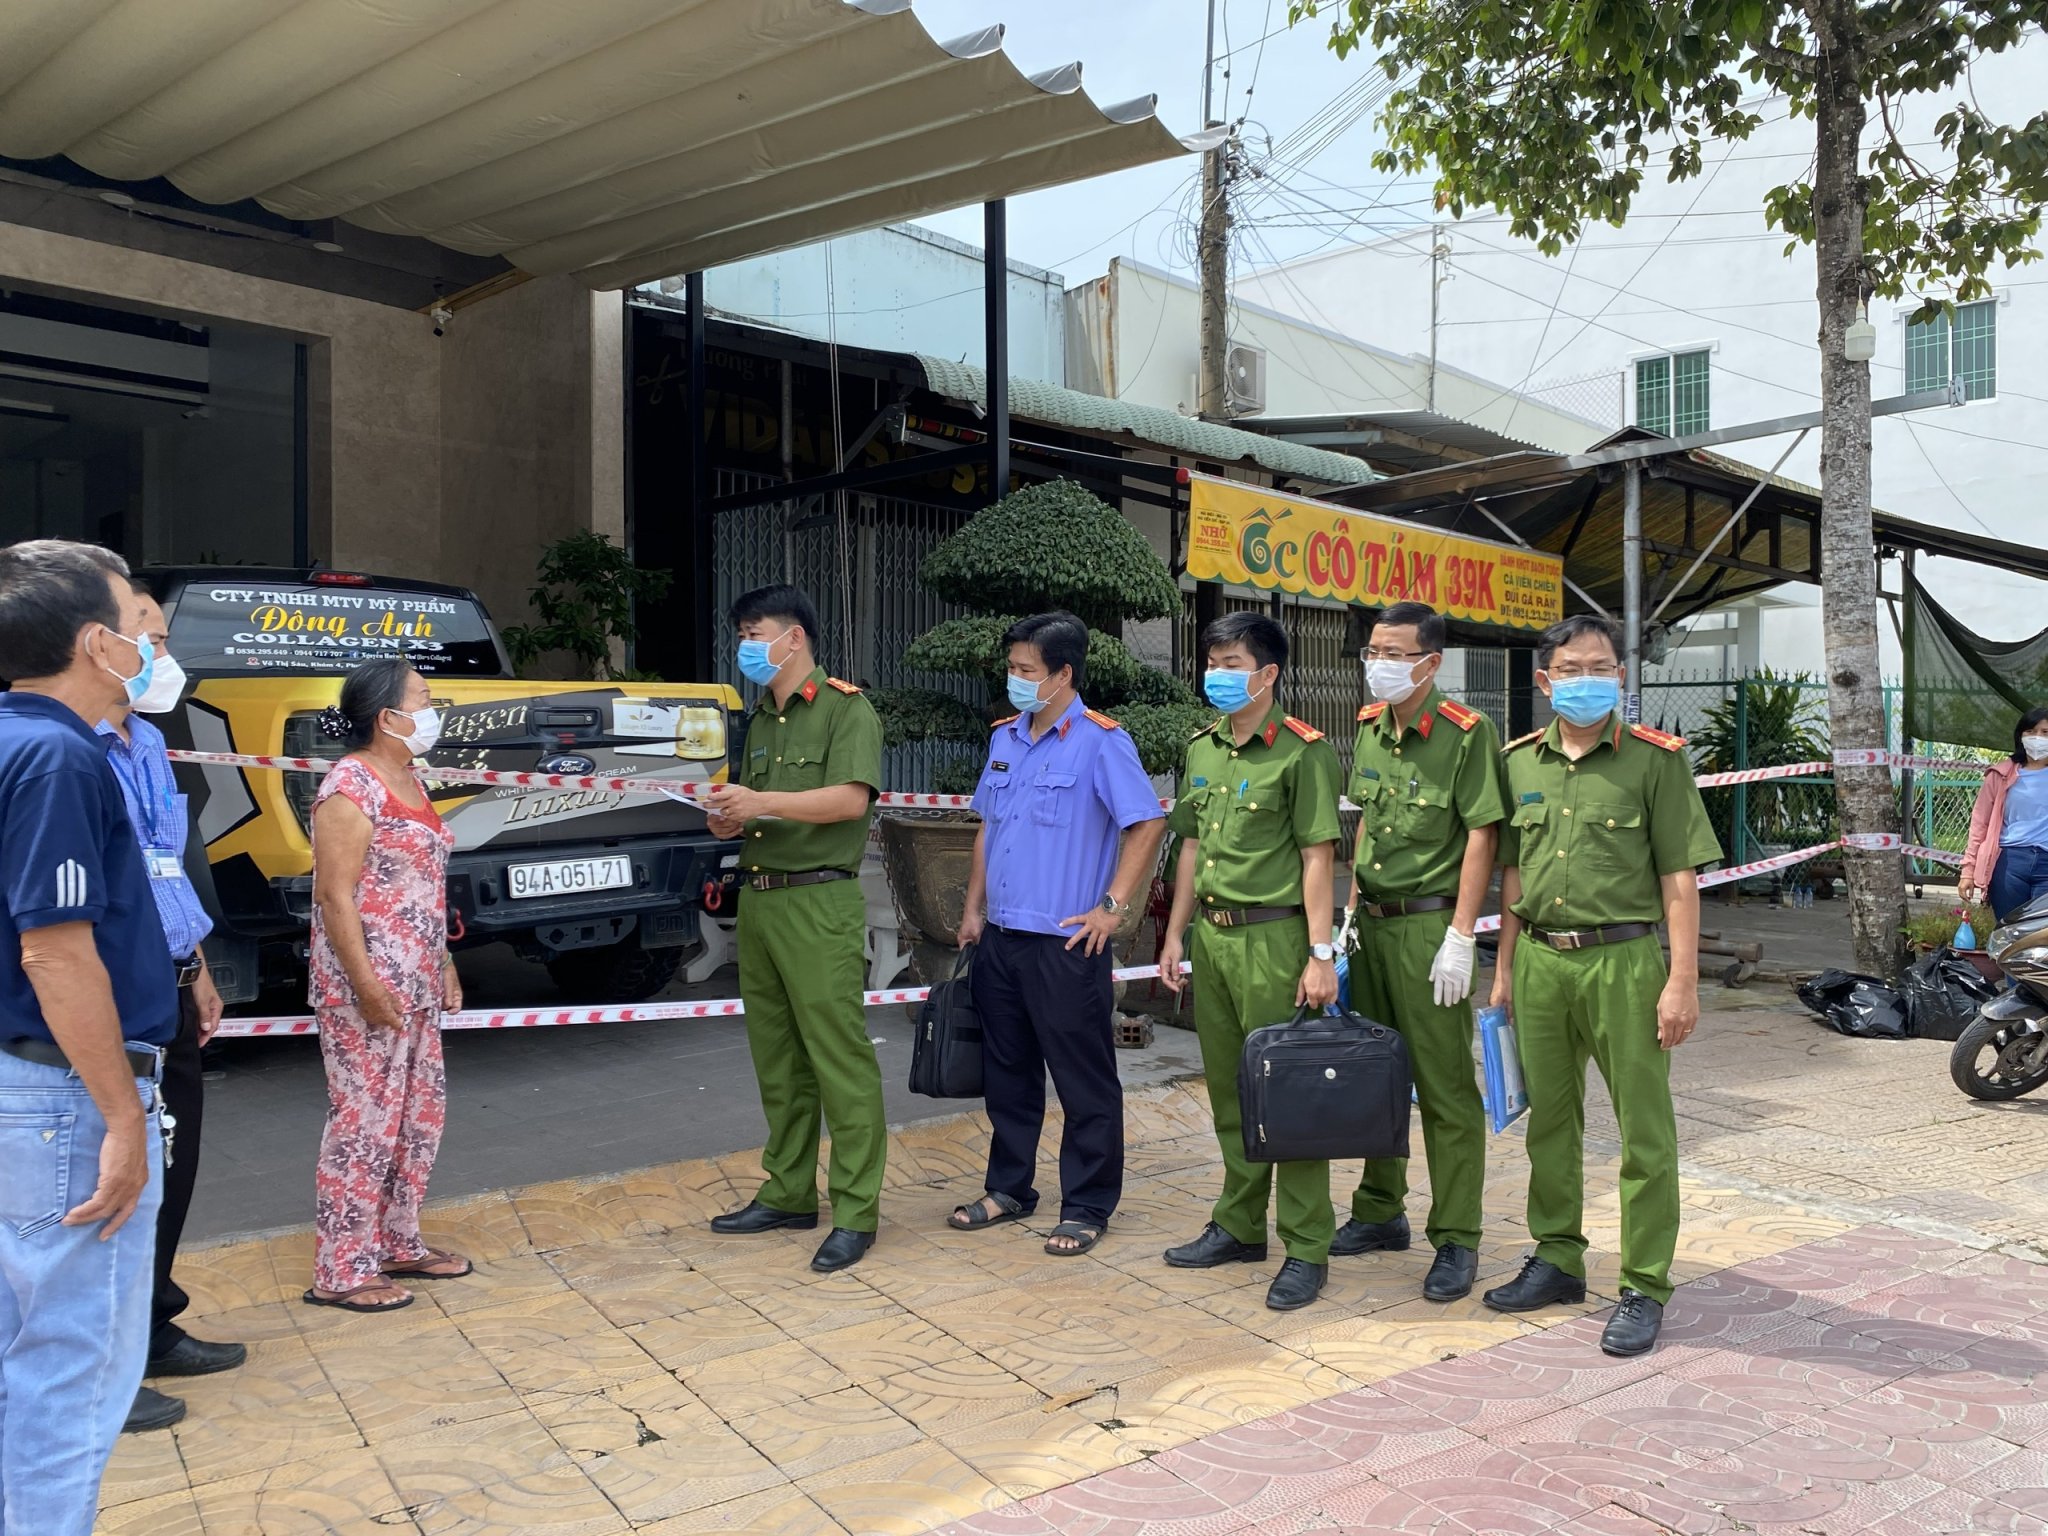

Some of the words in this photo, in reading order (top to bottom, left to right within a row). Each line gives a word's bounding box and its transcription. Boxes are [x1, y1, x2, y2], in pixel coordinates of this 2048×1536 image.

[1304, 517, 1356, 591] CÔ
[1360, 532, 1437, 604] TÁM
[1444, 555, 1497, 611] 39K
[210, 589, 254, 605] CTY
[259, 591, 319, 607] TNHH
[322, 594, 363, 609] MTV
[368, 595, 398, 611] MỸ
[402, 597, 456, 614] PHẨM
[250, 606, 350, 638] Đông
[233, 633, 399, 649] COLLAGEN
[407, 639, 444, 651] X3
[495, 786, 545, 798] WHITE
[597, 765, 637, 778] CREAM
[559, 760, 585, 773] Ford
[513, 857, 625, 895] 94A-051.71
